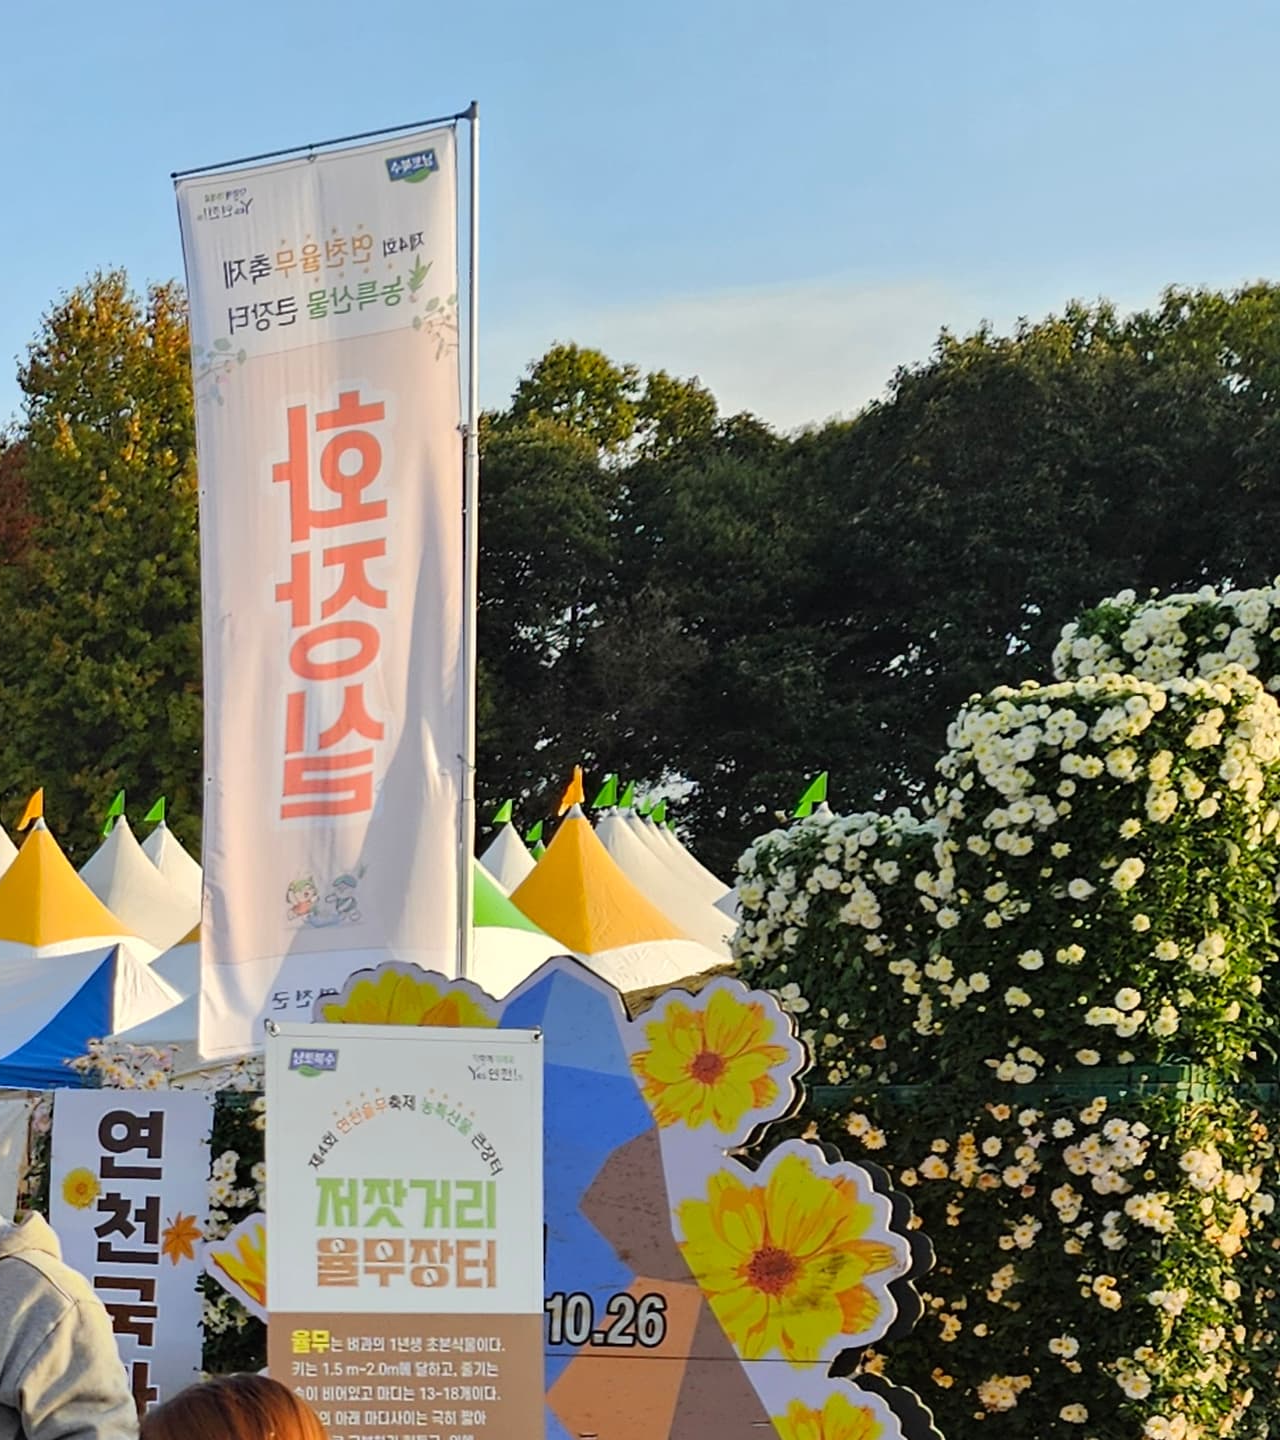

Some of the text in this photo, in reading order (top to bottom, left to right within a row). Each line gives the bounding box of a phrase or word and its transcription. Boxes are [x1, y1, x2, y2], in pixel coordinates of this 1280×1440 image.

[307, 1130, 339, 1171] 제4회
[471, 1131, 504, 1177] 큰장터
[315, 1177, 497, 1229] 저잣거리
[316, 1236, 498, 1289] 율무장터
[545, 1292, 666, 1347] 10.26
[291, 1329, 506, 1354] 율무는 벼과의 1년생 초본식물이다.
[291, 1360, 318, 1377] 키는
[322, 1361, 343, 1376] 1.5
[415, 1360, 458, 1377] 달하고,
[322, 1385, 374, 1401] 비어있고
[377, 1385, 416, 1401] 마디는
[420, 1385, 502, 1401] 13-18개이다.
[335, 1410, 360, 1426] 아래
[364, 1410, 427, 1427] 마디사이는
[431, 1410, 457, 1426] 극히
